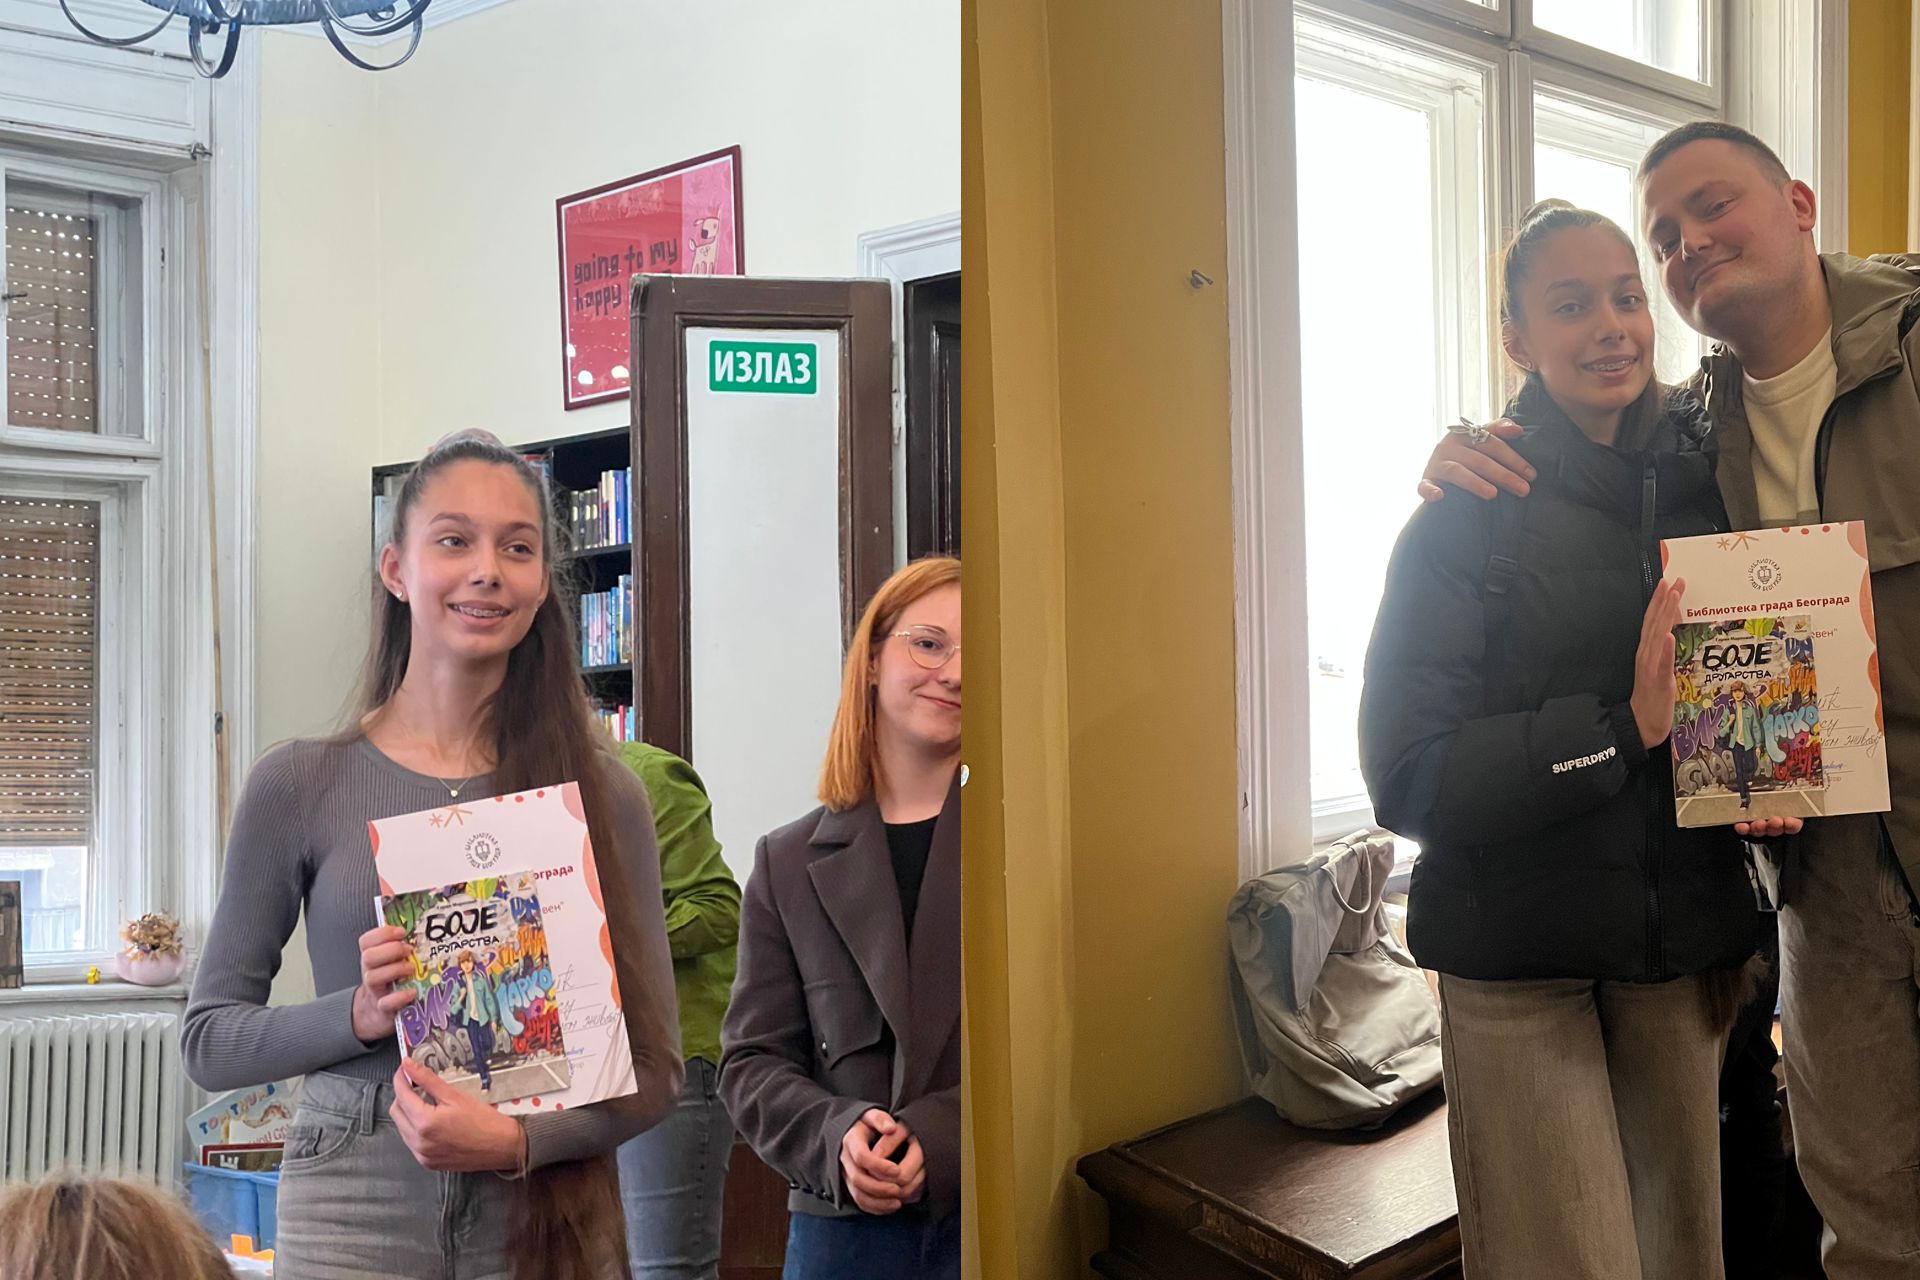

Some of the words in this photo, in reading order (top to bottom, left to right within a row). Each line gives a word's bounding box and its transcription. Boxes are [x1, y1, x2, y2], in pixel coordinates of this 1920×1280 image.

[574, 252, 619, 285] going
[624, 244, 643, 271] to
[650, 238, 678, 265] my
[575, 283, 622, 317] happy
[714, 350, 811, 385] ИЗЛАЗ
[1687, 604, 1757, 617] Библиотека
[1760, 602, 1793, 613] града
[1796, 595, 1850, 608] Београда
[1702, 641, 1773, 670] БОЈЕ
[1704, 669, 1772, 684] ДРУГАРСТВА
[533, 864, 574, 880] ограда
[426, 904, 498, 942] БОЈЕ
[429, 936, 500, 958] ДРУГАРСТВА
[199, 1109, 231, 1135] TOM
[230, 1083, 275, 1116] THUMB
